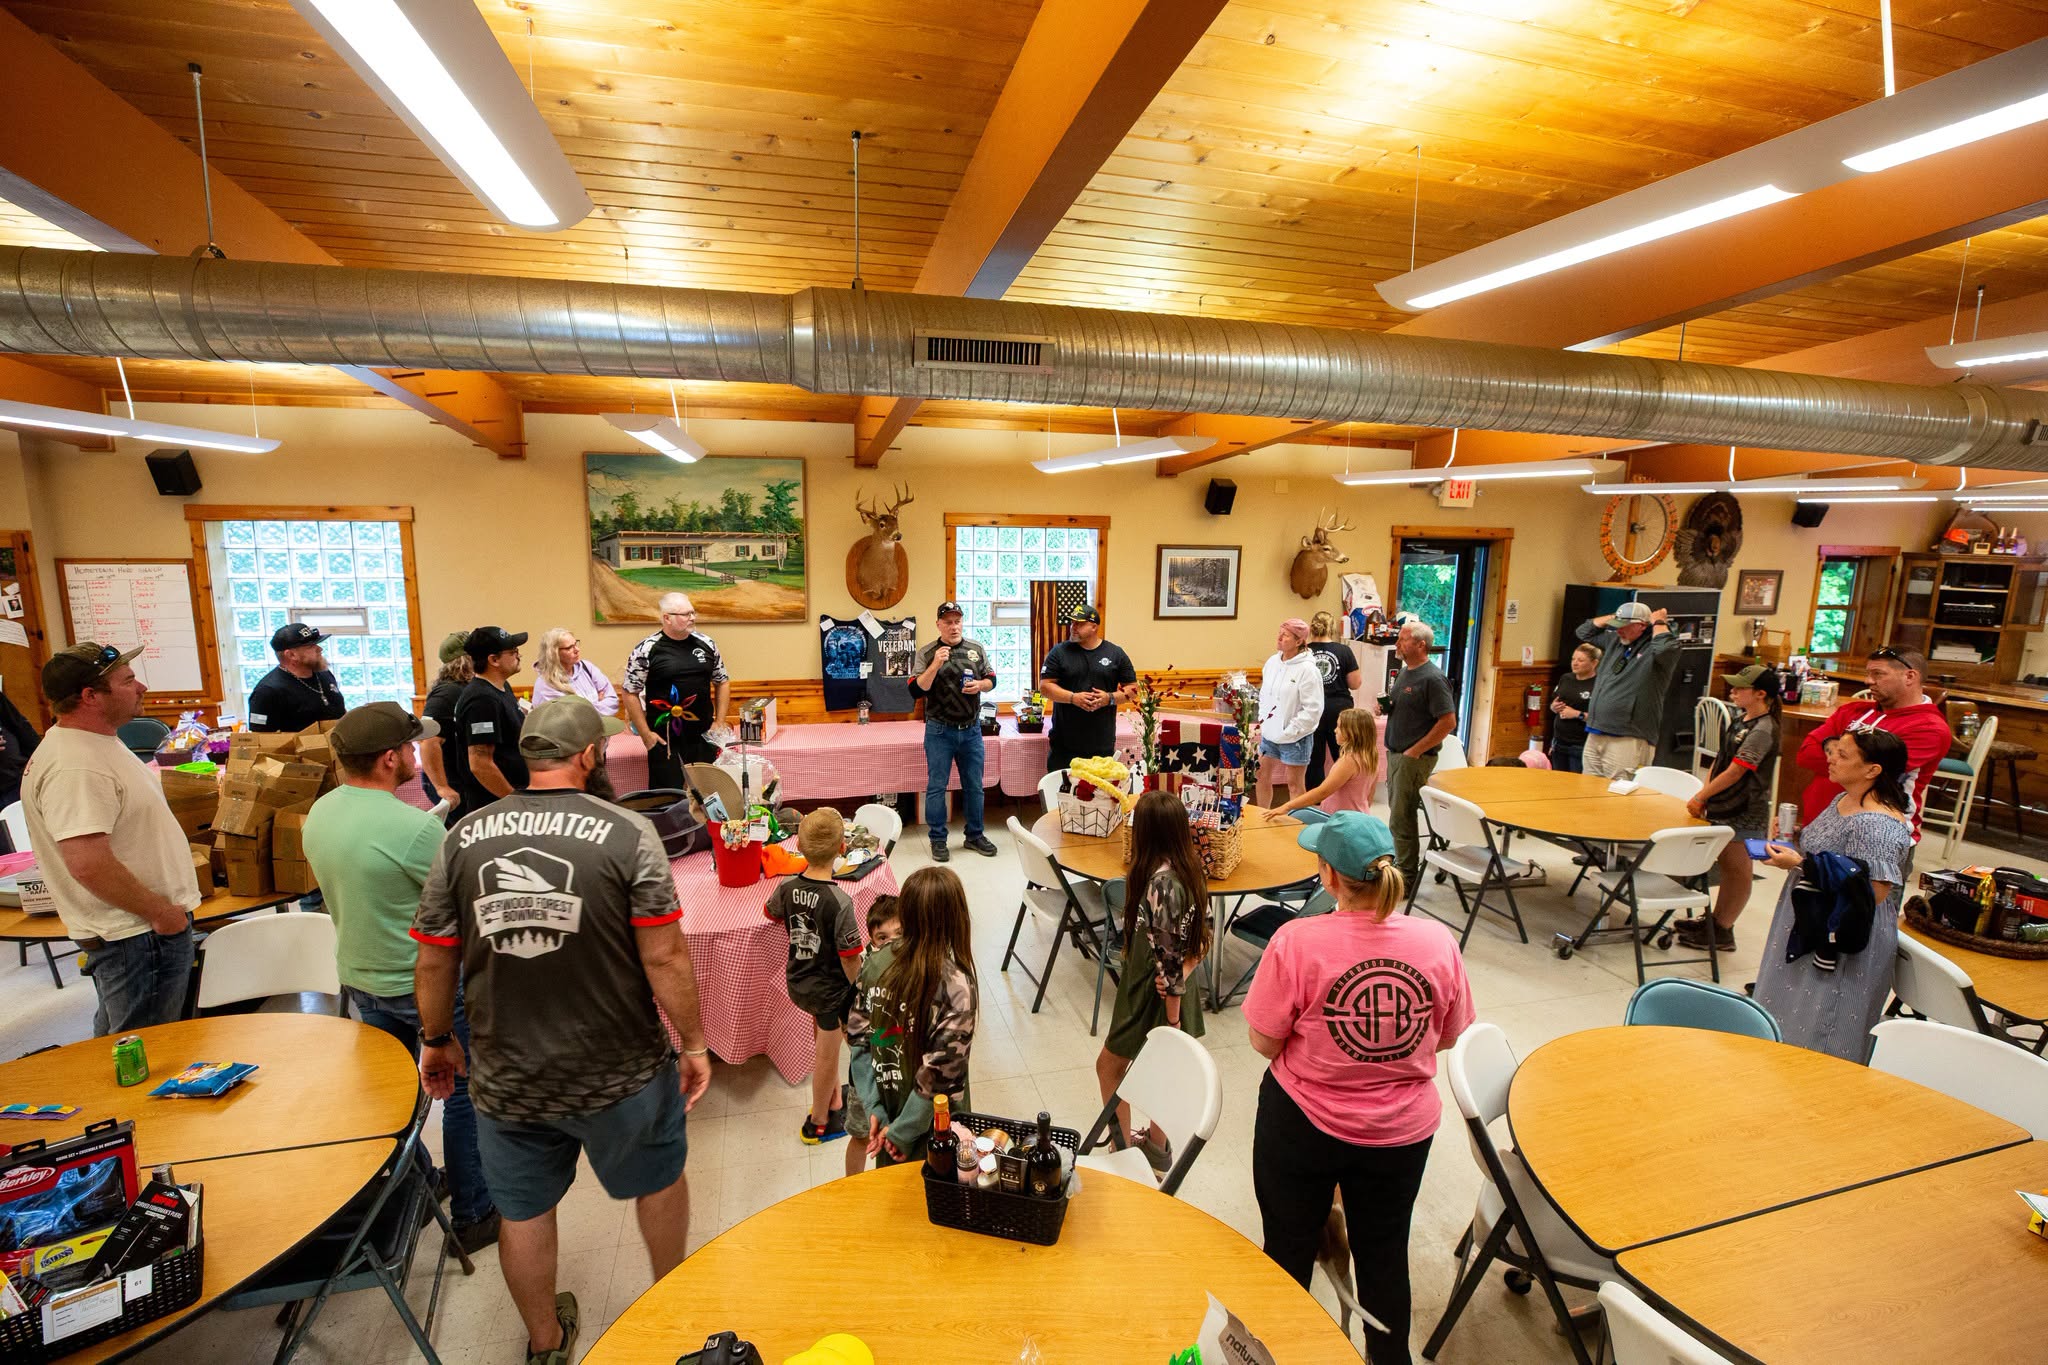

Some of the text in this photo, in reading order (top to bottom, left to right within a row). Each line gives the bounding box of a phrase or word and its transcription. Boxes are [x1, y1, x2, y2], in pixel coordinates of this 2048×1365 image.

[459, 811, 614, 849] SAMSQUATCH
[480, 897, 575, 916] SHERWOOD FOREST
[792, 888, 819, 909] GOOD
[503, 909, 549, 922] BOWMEN
[1333, 960, 1430, 992] SHERWOOD FOREST
[1352, 983, 1412, 1043] SFB
[0, 1169, 47, 1190] Berkley
